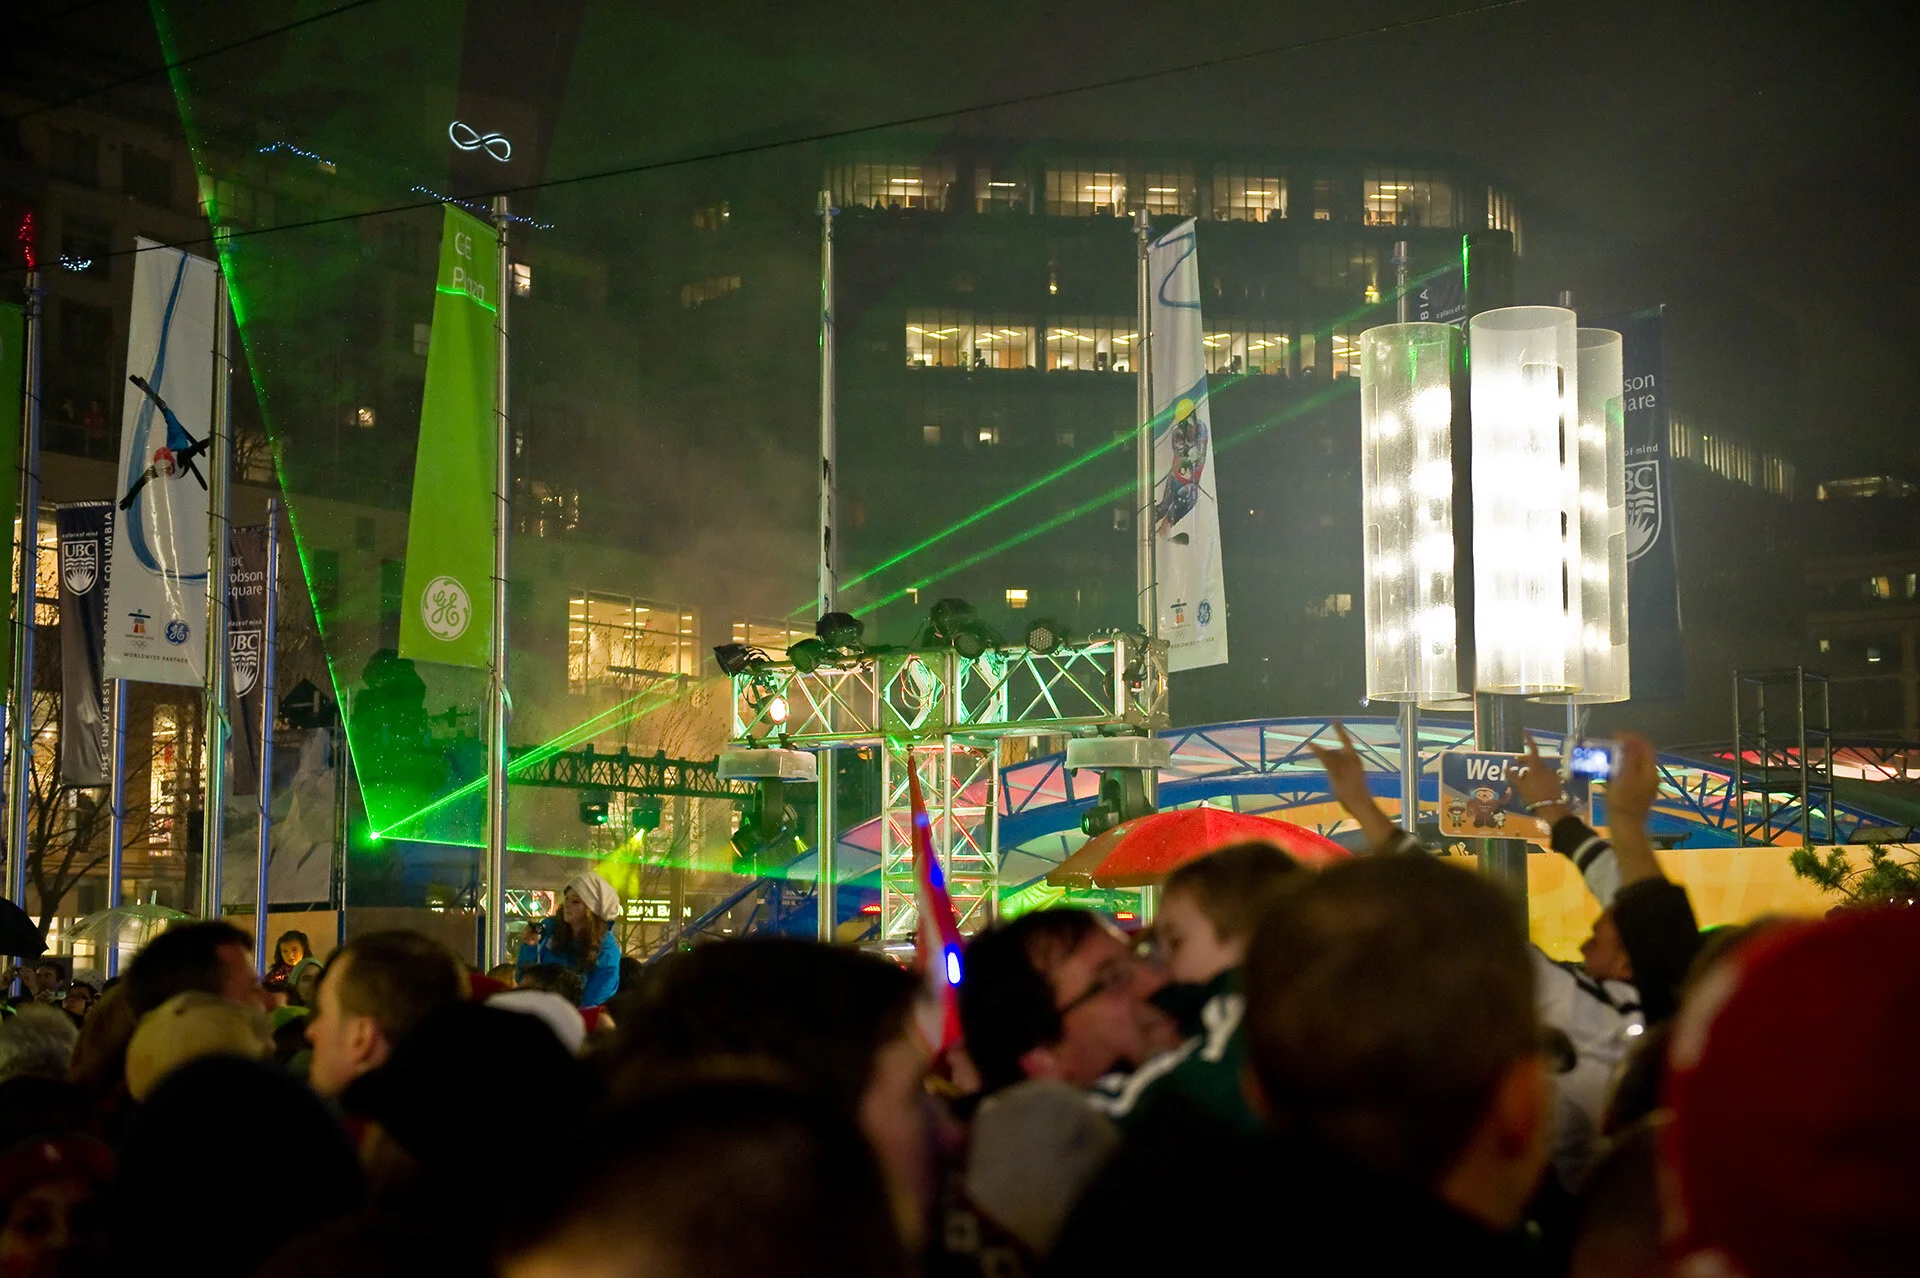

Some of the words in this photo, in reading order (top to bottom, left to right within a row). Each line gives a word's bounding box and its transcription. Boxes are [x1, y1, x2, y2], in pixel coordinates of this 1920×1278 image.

[455, 232, 472, 260] GE
[1624, 374, 1655, 392] son
[1624, 394, 1656, 411] are
[1625, 466, 1654, 493] BC
[65, 543, 95, 558] UBC
[228, 570, 263, 583] obson
[102, 681, 110, 747] UNIVERSI
